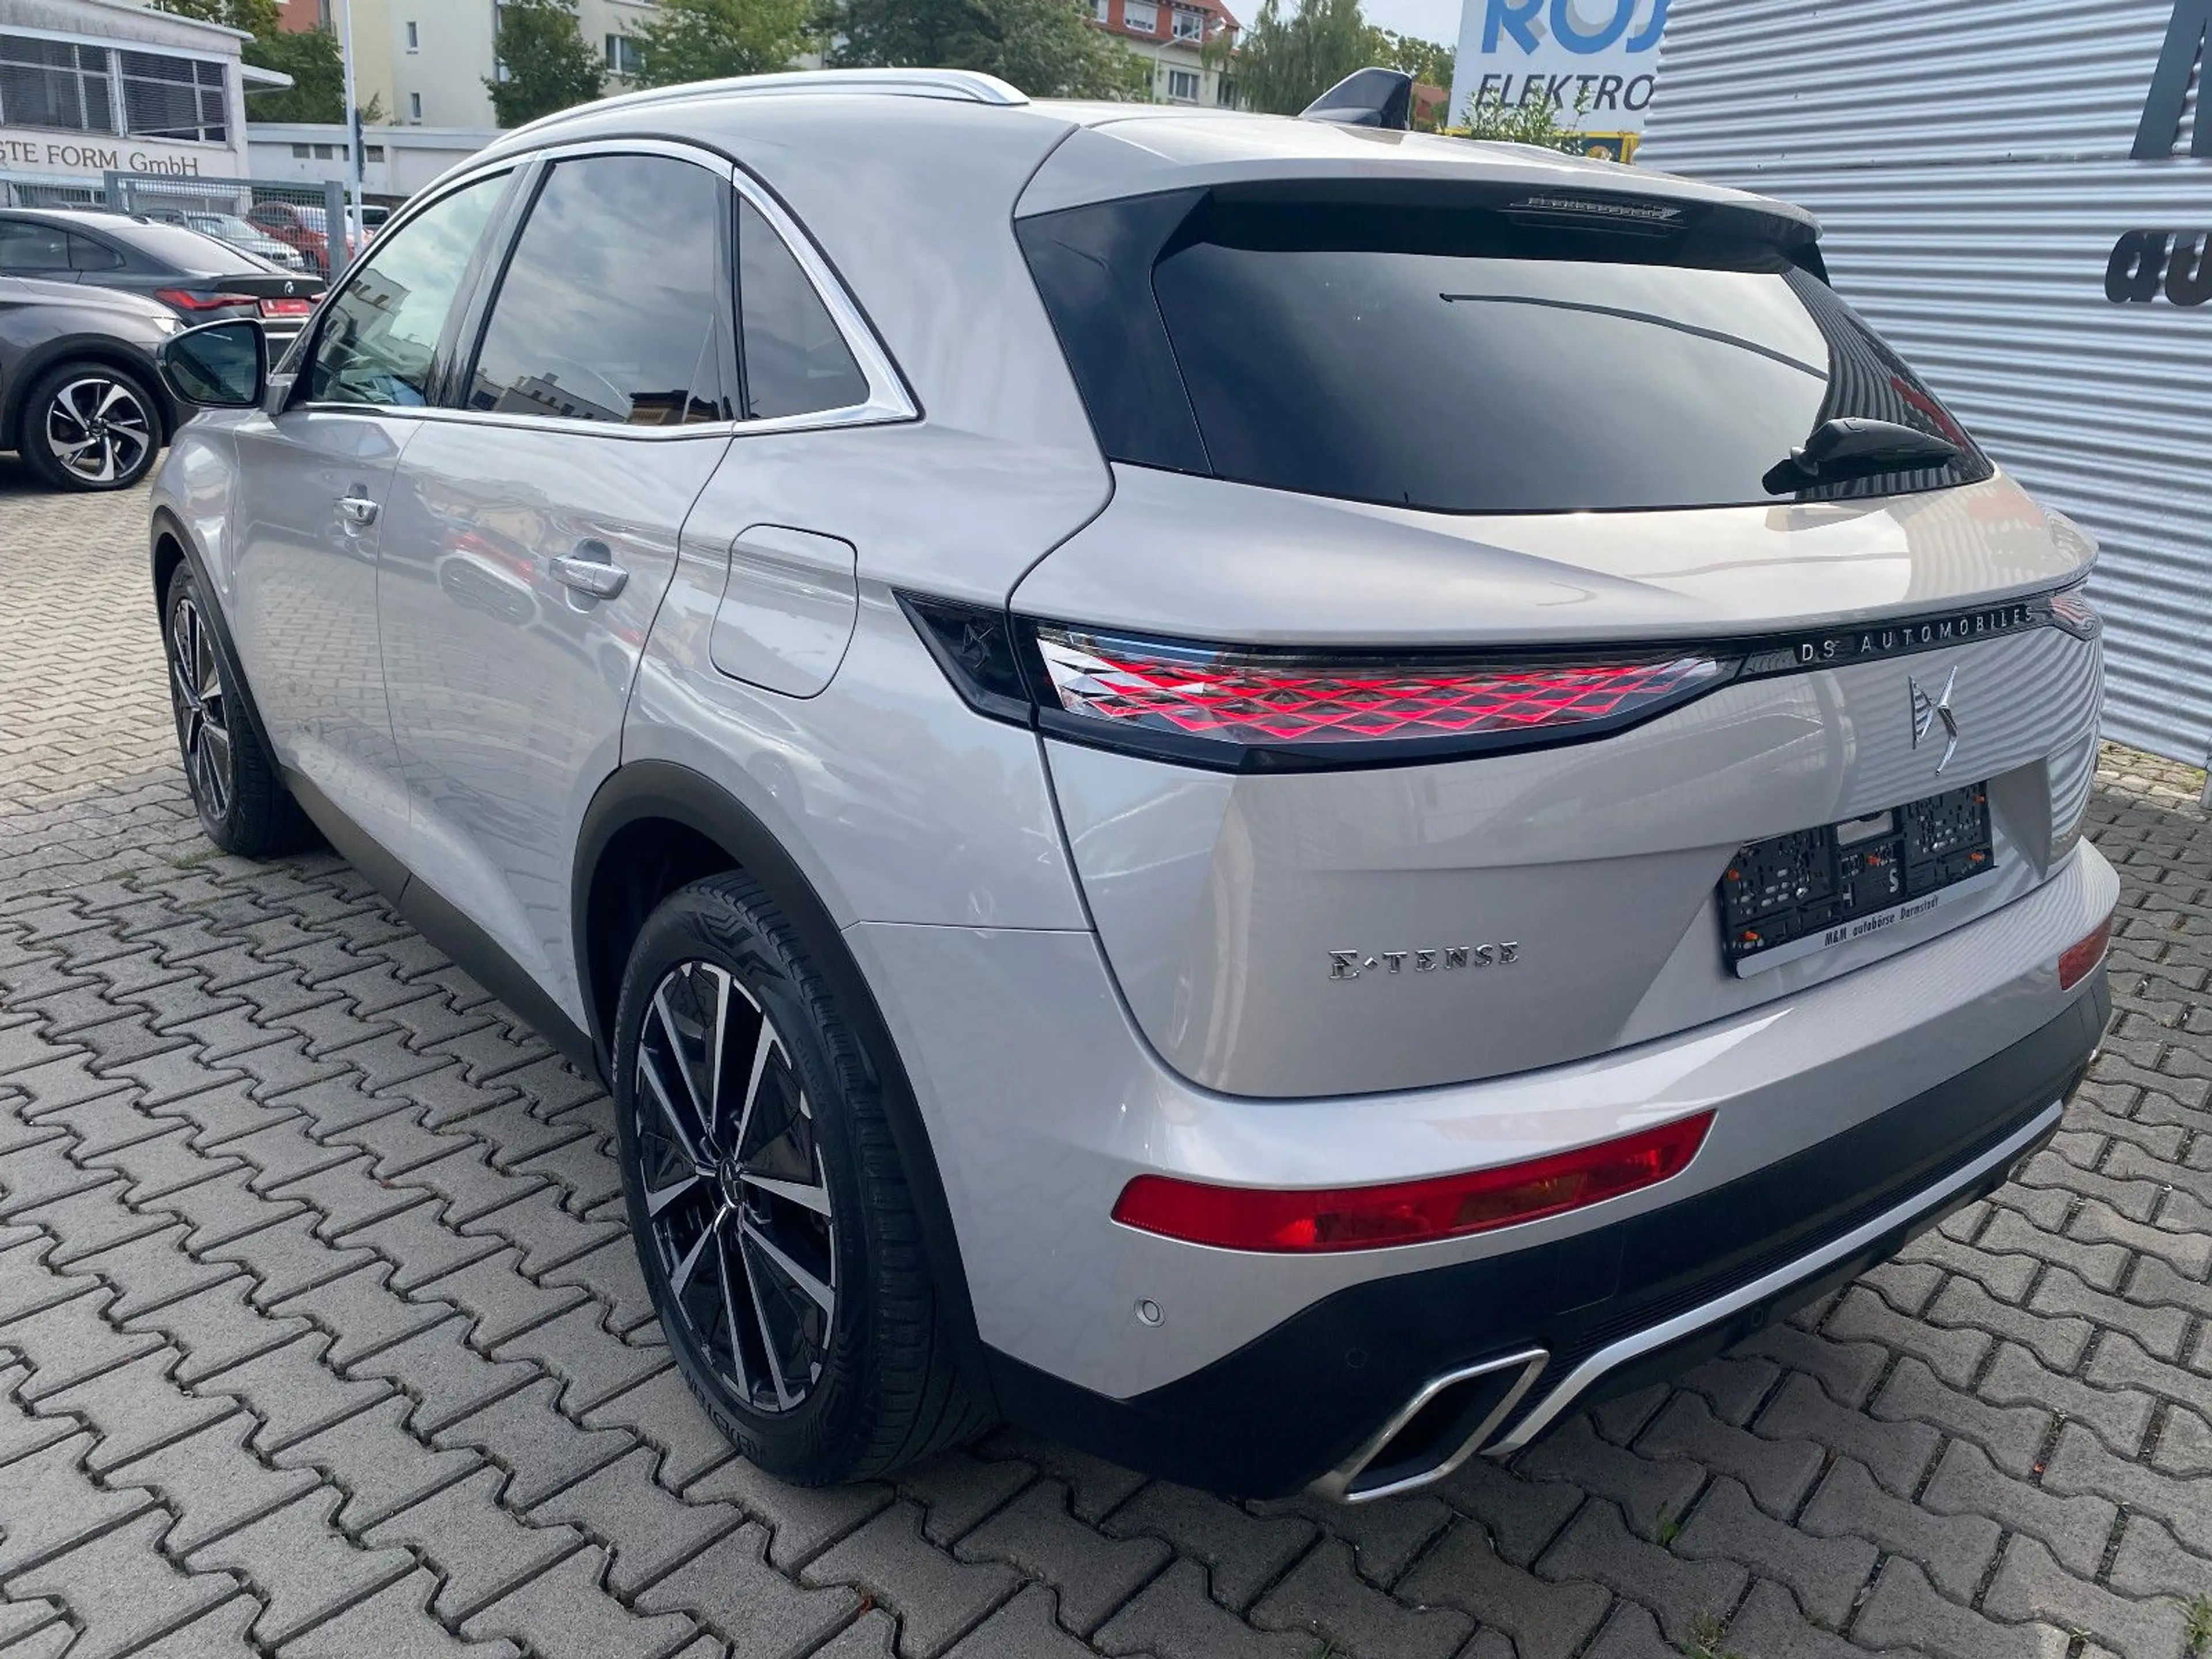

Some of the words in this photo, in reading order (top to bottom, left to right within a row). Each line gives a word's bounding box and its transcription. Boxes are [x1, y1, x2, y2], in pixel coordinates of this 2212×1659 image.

[1475, 74, 1656, 111] ELEKTRO
[47, 145, 119, 169] FORM
[129, 152, 199, 176] GmbH
[1802, 640, 1839, 661] DS
[1860, 606, 2033, 653] AUTOMOBILES
[1824, 927, 1847, 946] M&M
[1900, 894, 1939, 920] Darmstadt
